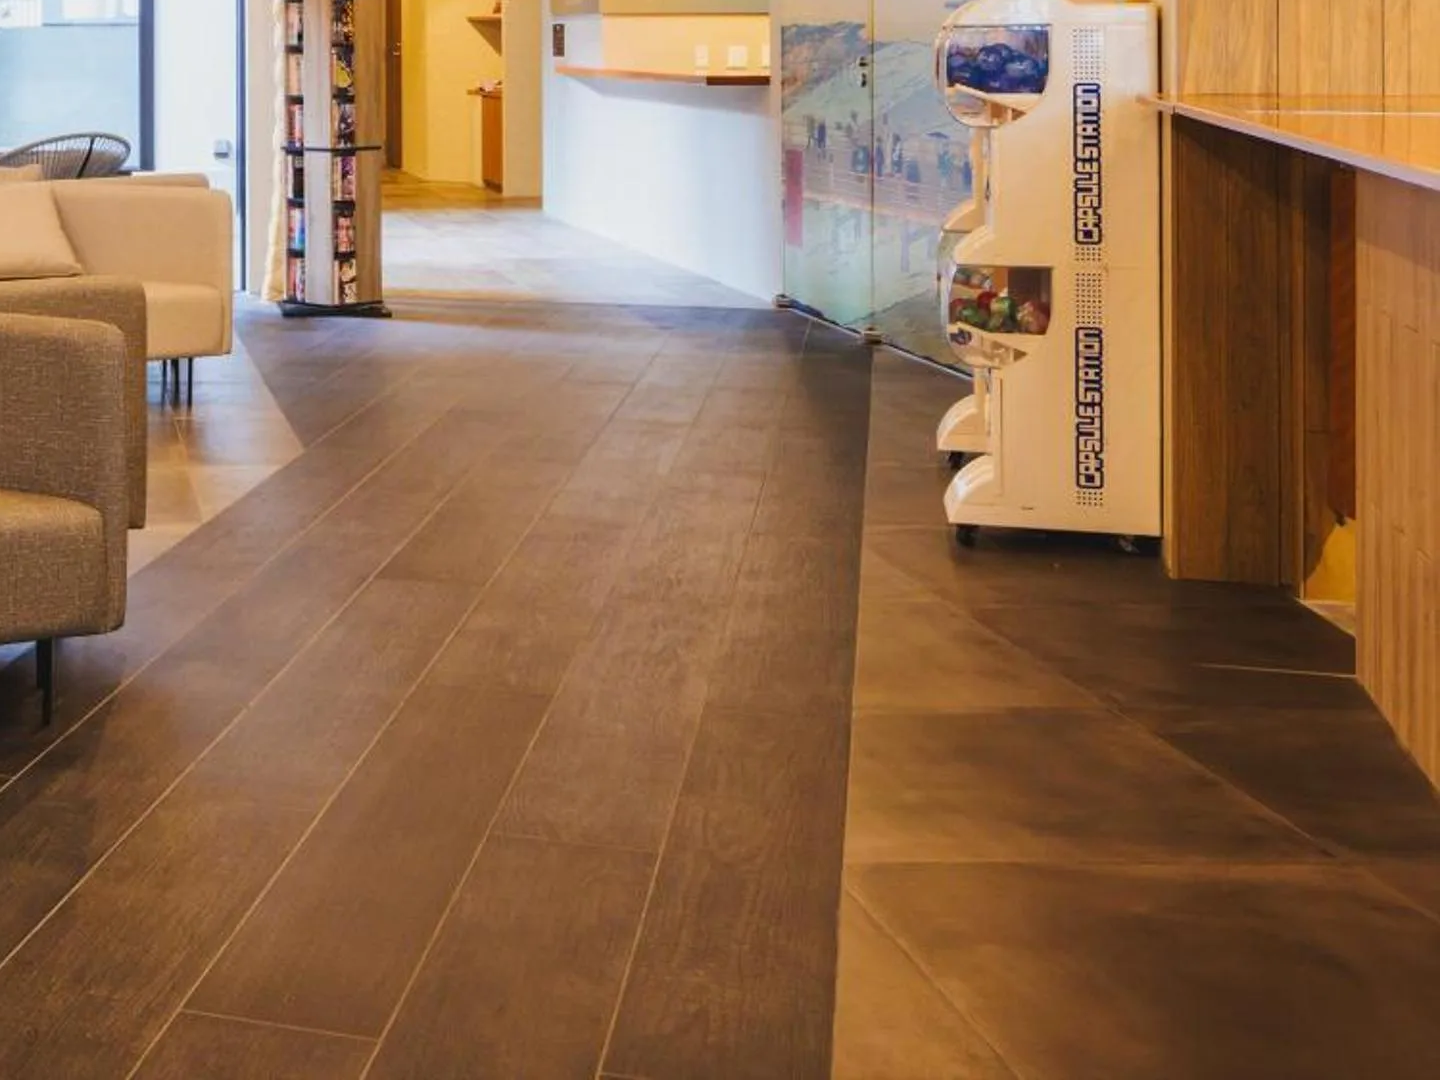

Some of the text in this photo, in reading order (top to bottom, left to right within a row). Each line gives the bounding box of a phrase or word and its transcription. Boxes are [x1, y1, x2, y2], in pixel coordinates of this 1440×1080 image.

[1074, 83, 1101, 244] CAPSULE STATION
[1076, 327, 1103, 488] CAPSULE STATION
